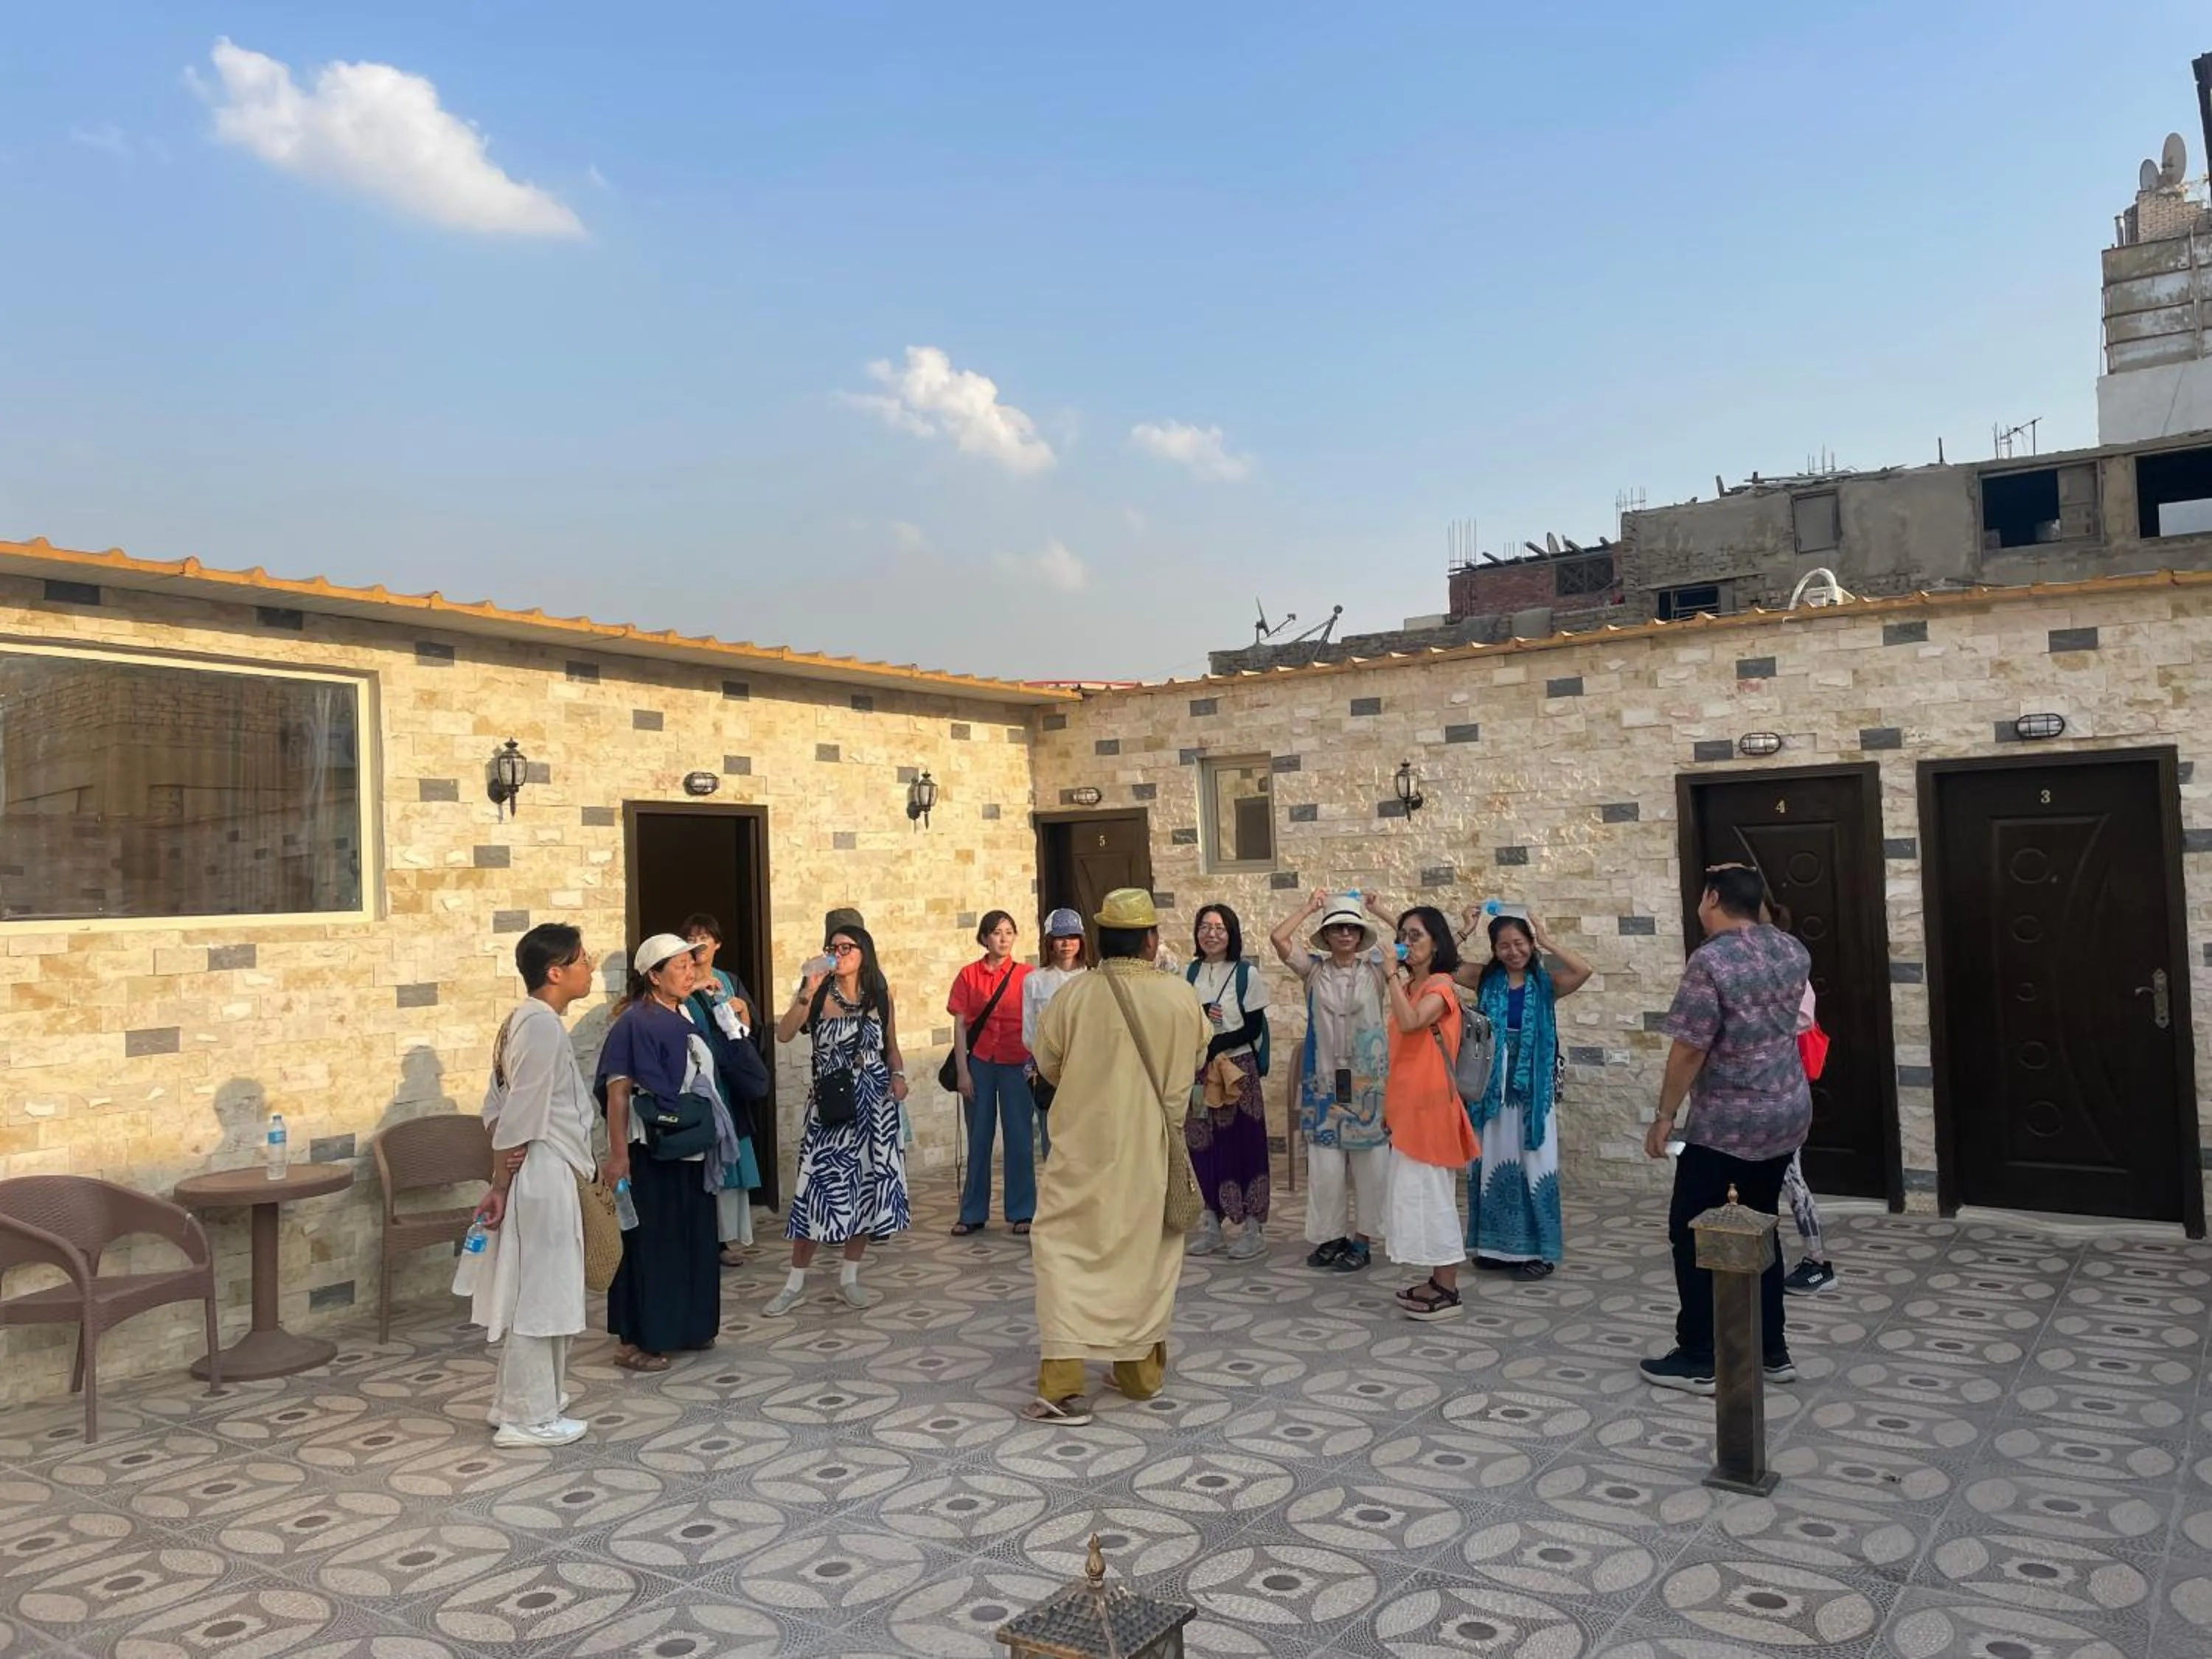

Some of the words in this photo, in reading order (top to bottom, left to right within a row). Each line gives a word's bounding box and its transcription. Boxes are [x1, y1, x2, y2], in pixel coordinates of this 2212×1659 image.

[2041, 790, 2051, 803] 3
[1775, 800, 1785, 813] 4
[1099, 835, 1105, 847] 5
